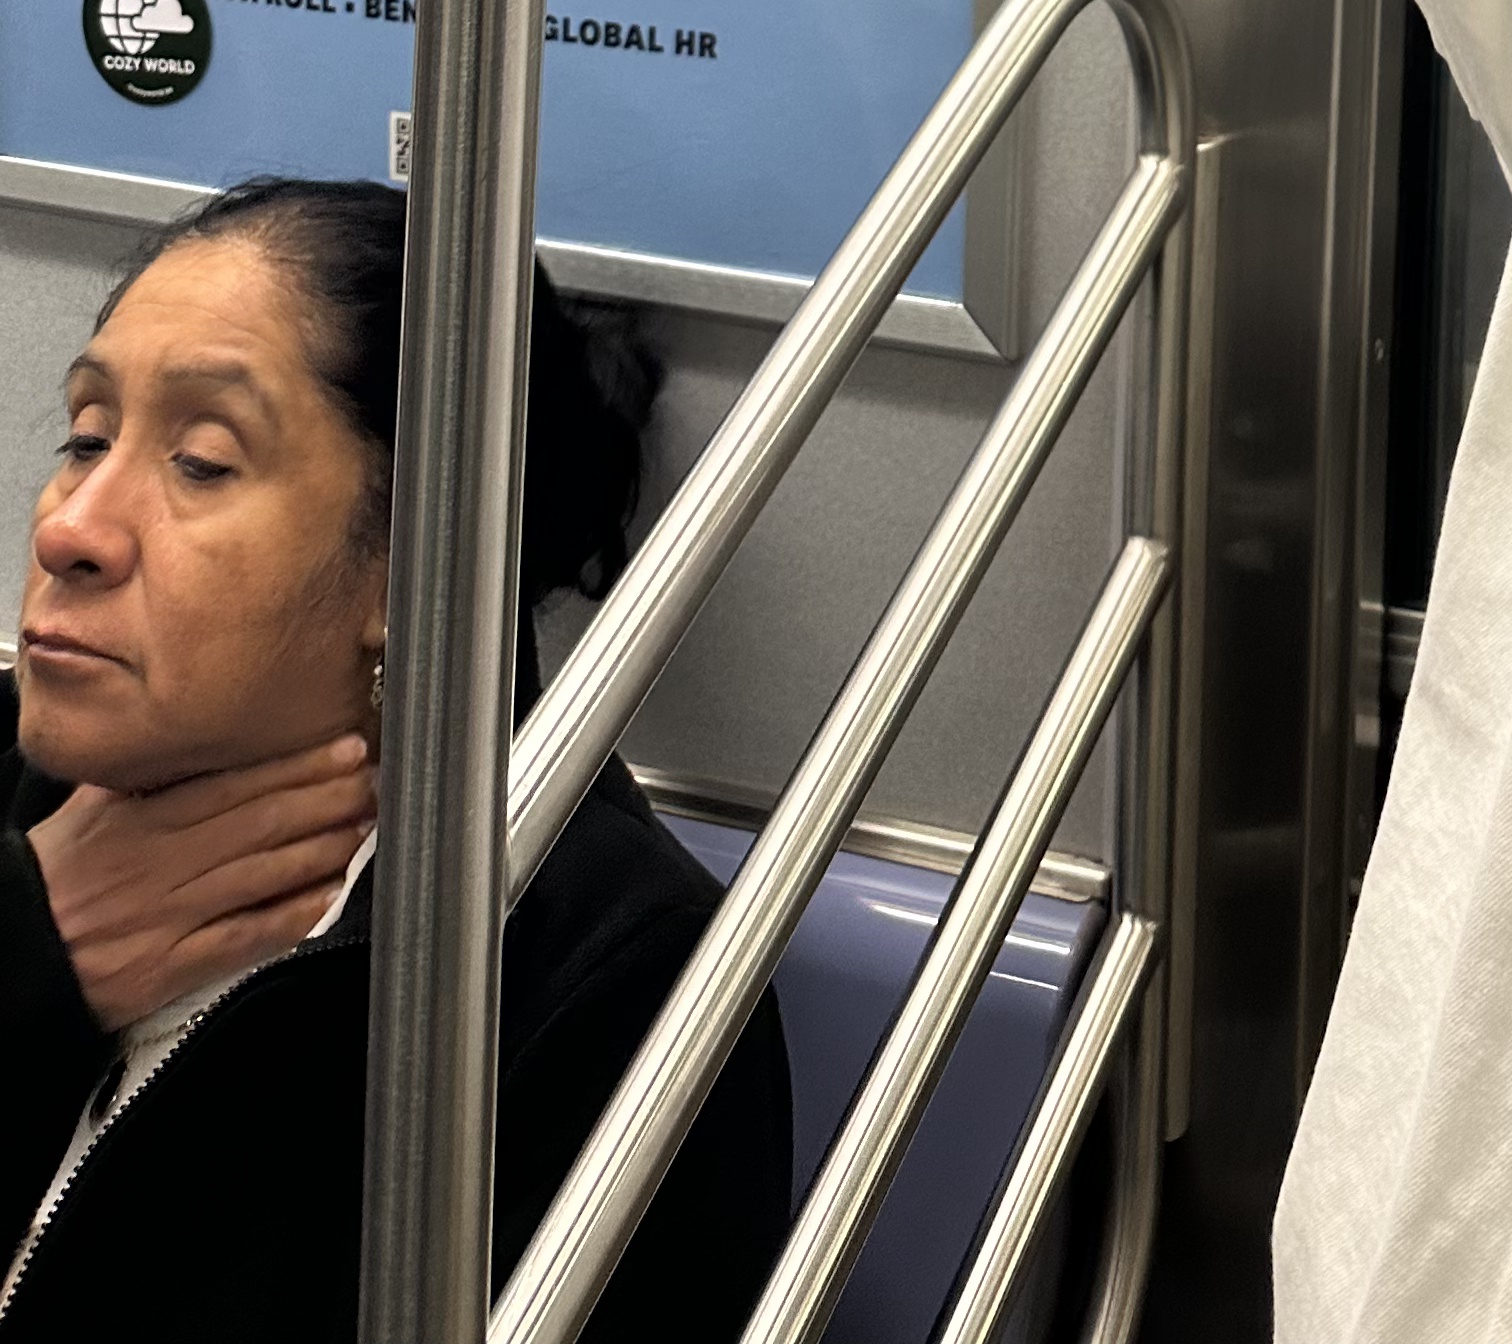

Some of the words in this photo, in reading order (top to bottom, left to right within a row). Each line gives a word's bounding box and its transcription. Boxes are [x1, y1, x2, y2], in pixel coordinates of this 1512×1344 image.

[545, 15, 664, 53] GLOBAL
[674, 29, 717, 59] HR
[103, 55, 141, 72] COZY
[143, 58, 197, 75] WORLD
